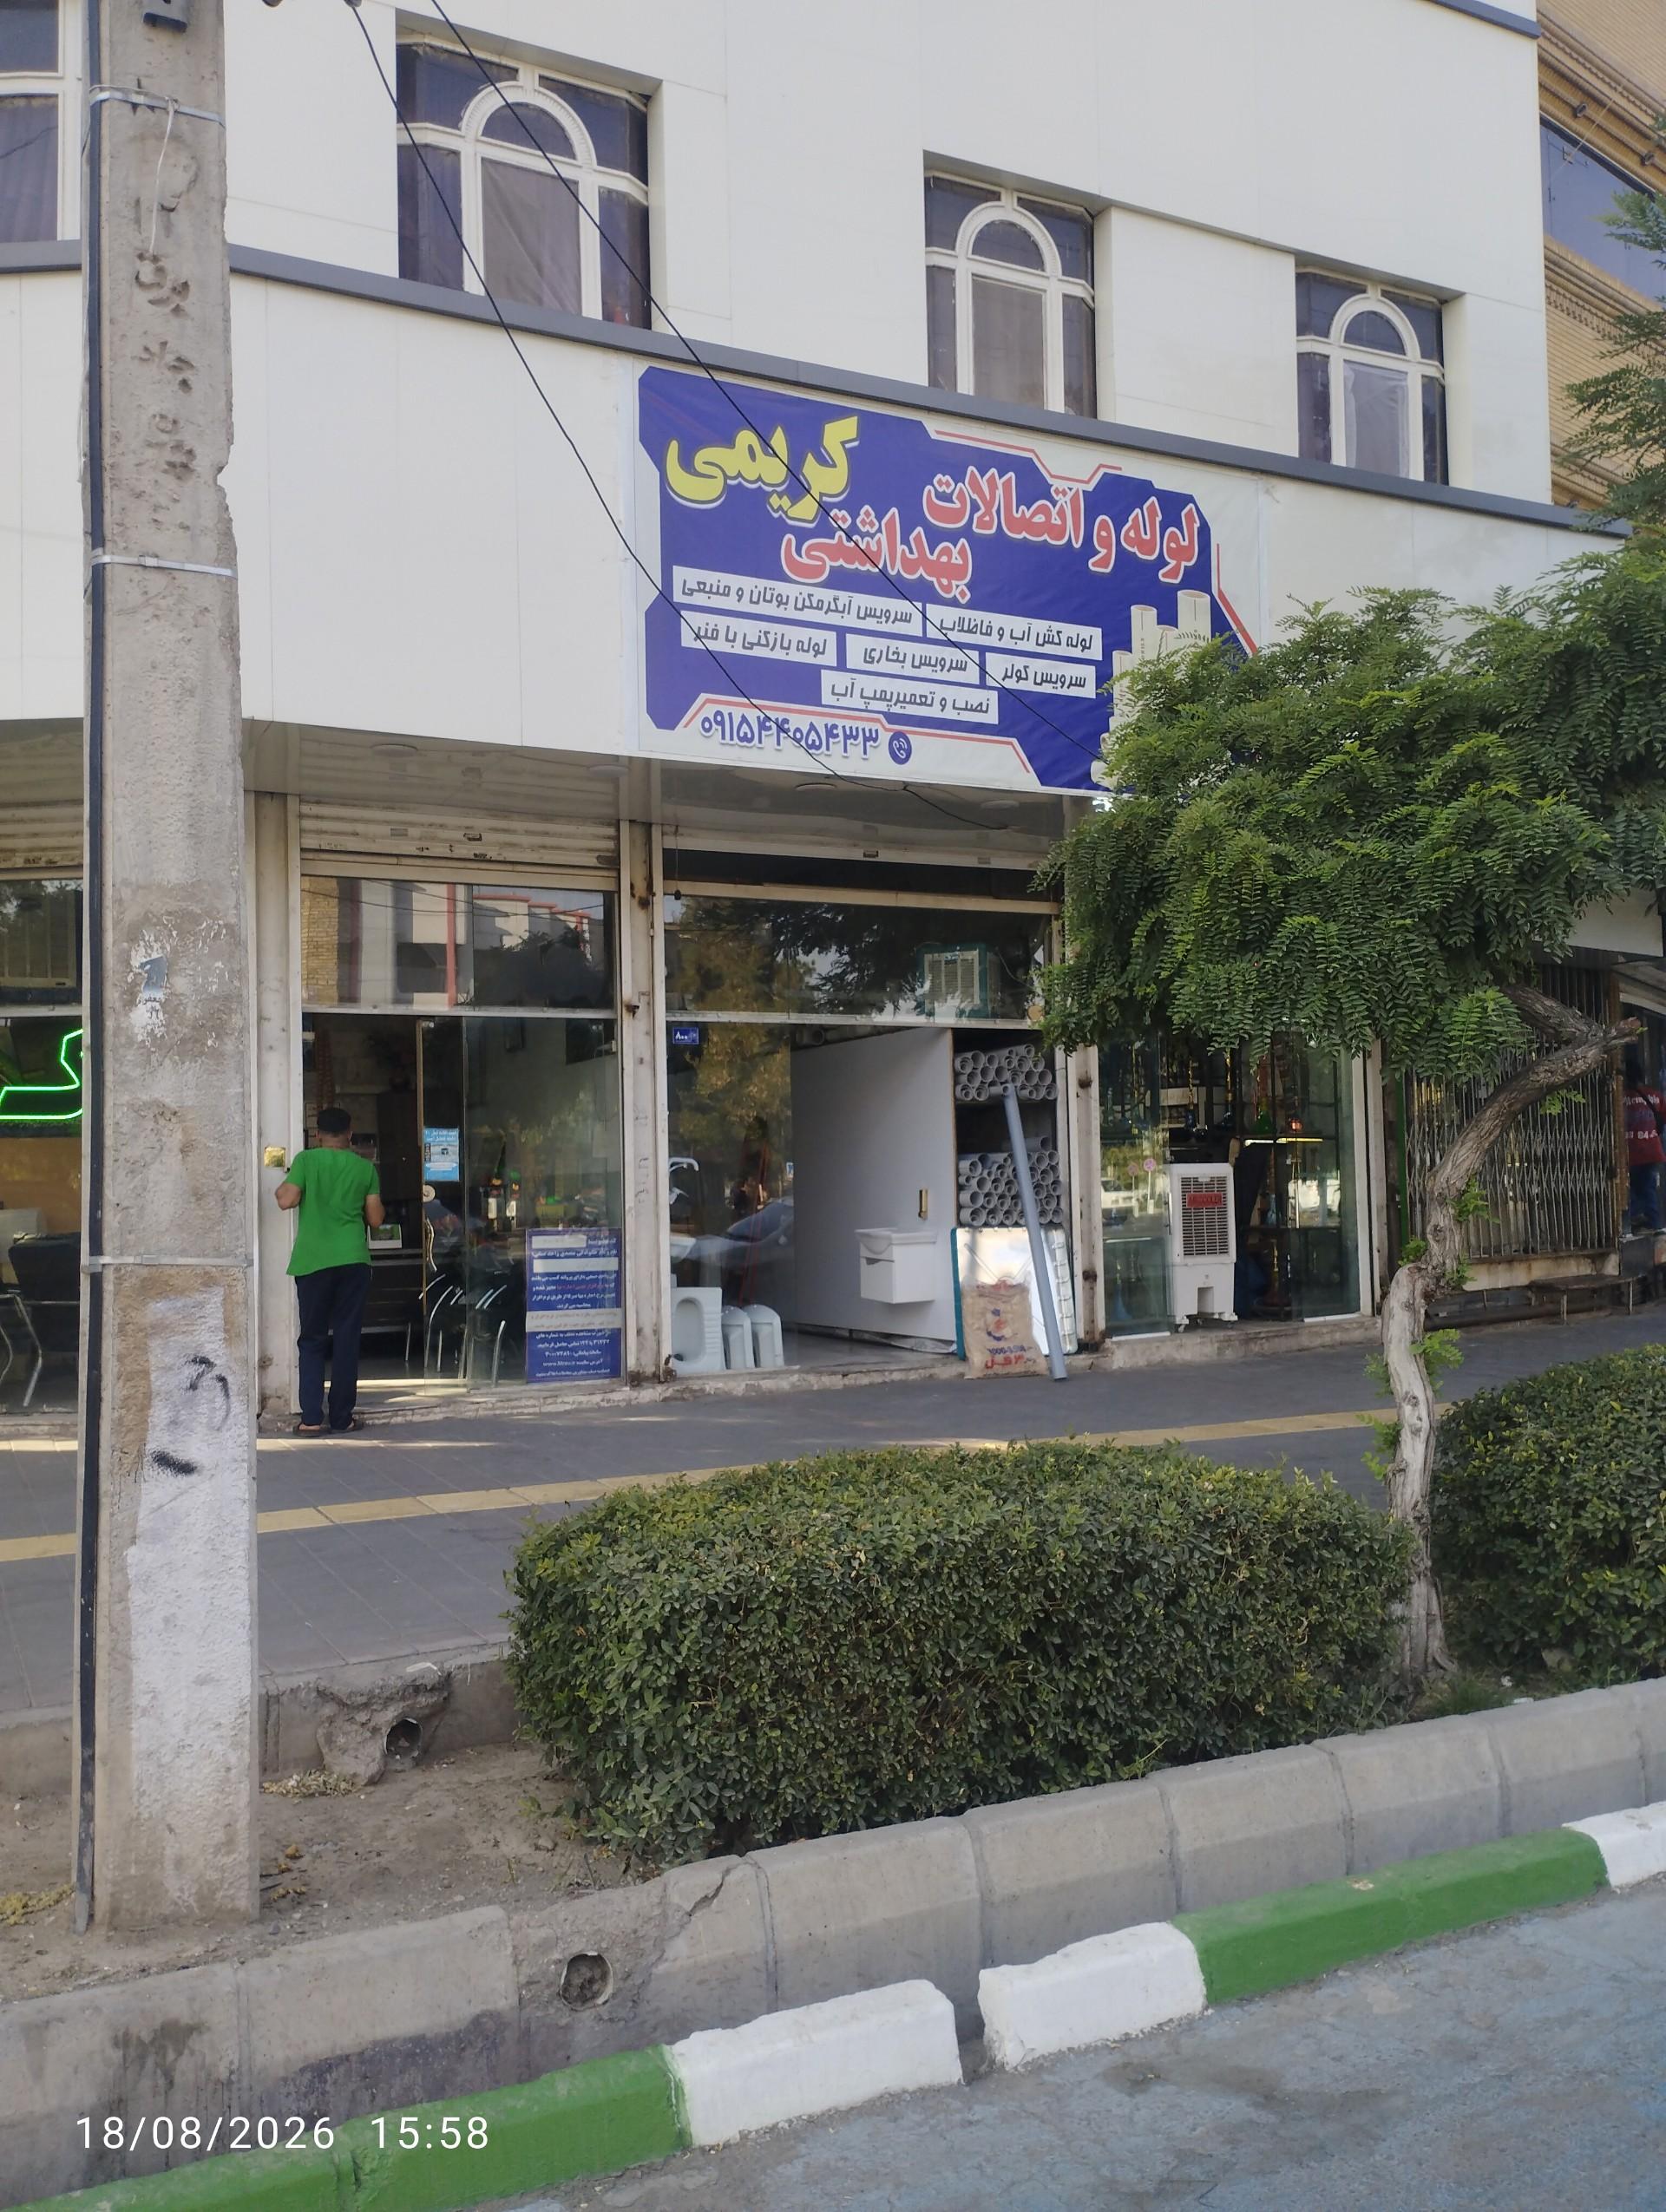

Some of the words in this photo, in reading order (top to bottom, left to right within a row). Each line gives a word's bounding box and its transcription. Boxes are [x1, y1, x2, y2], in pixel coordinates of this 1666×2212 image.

[665, 415, 860, 525] کریمی
[922, 466, 1084, 548] اتصالات
[1088, 514, 1116, 573] و
[1120, 496, 1200, 584] لوله
[781, 505, 972, 604] بهداشتی
[681, 578, 731, 600] منبعی
[737, 587, 744, 603] و
[749, 585, 790, 610] بوتان
[793, 592, 854, 619] آبگرمکن
[856, 604, 912, 625] سرویس
[693, 621, 719, 643] فنر
[725, 625, 738, 649] با
[939, 615, 994, 638] فاظلاب
[997, 628, 1006, 642] و
[1009, 622, 1033, 646] آب
[1035, 625, 1063, 647] کش
[741, 630, 792, 657] بازکنی
[796, 636, 828, 659] لوله
[1066, 633, 1093, 654] لوله
[863, 645, 908, 670] بخاری
[911, 651, 969, 674] سرویس
[1001, 663, 1031, 684] کولر
[1033, 669, 1087, 690] سرویس
[830, 677, 857, 703] آب
[939, 697, 948, 712] و
[952, 697, 991, 716] نصب
[699, 709, 881, 757] ۰۹۱۵۴۴۰۵۴۳۳
